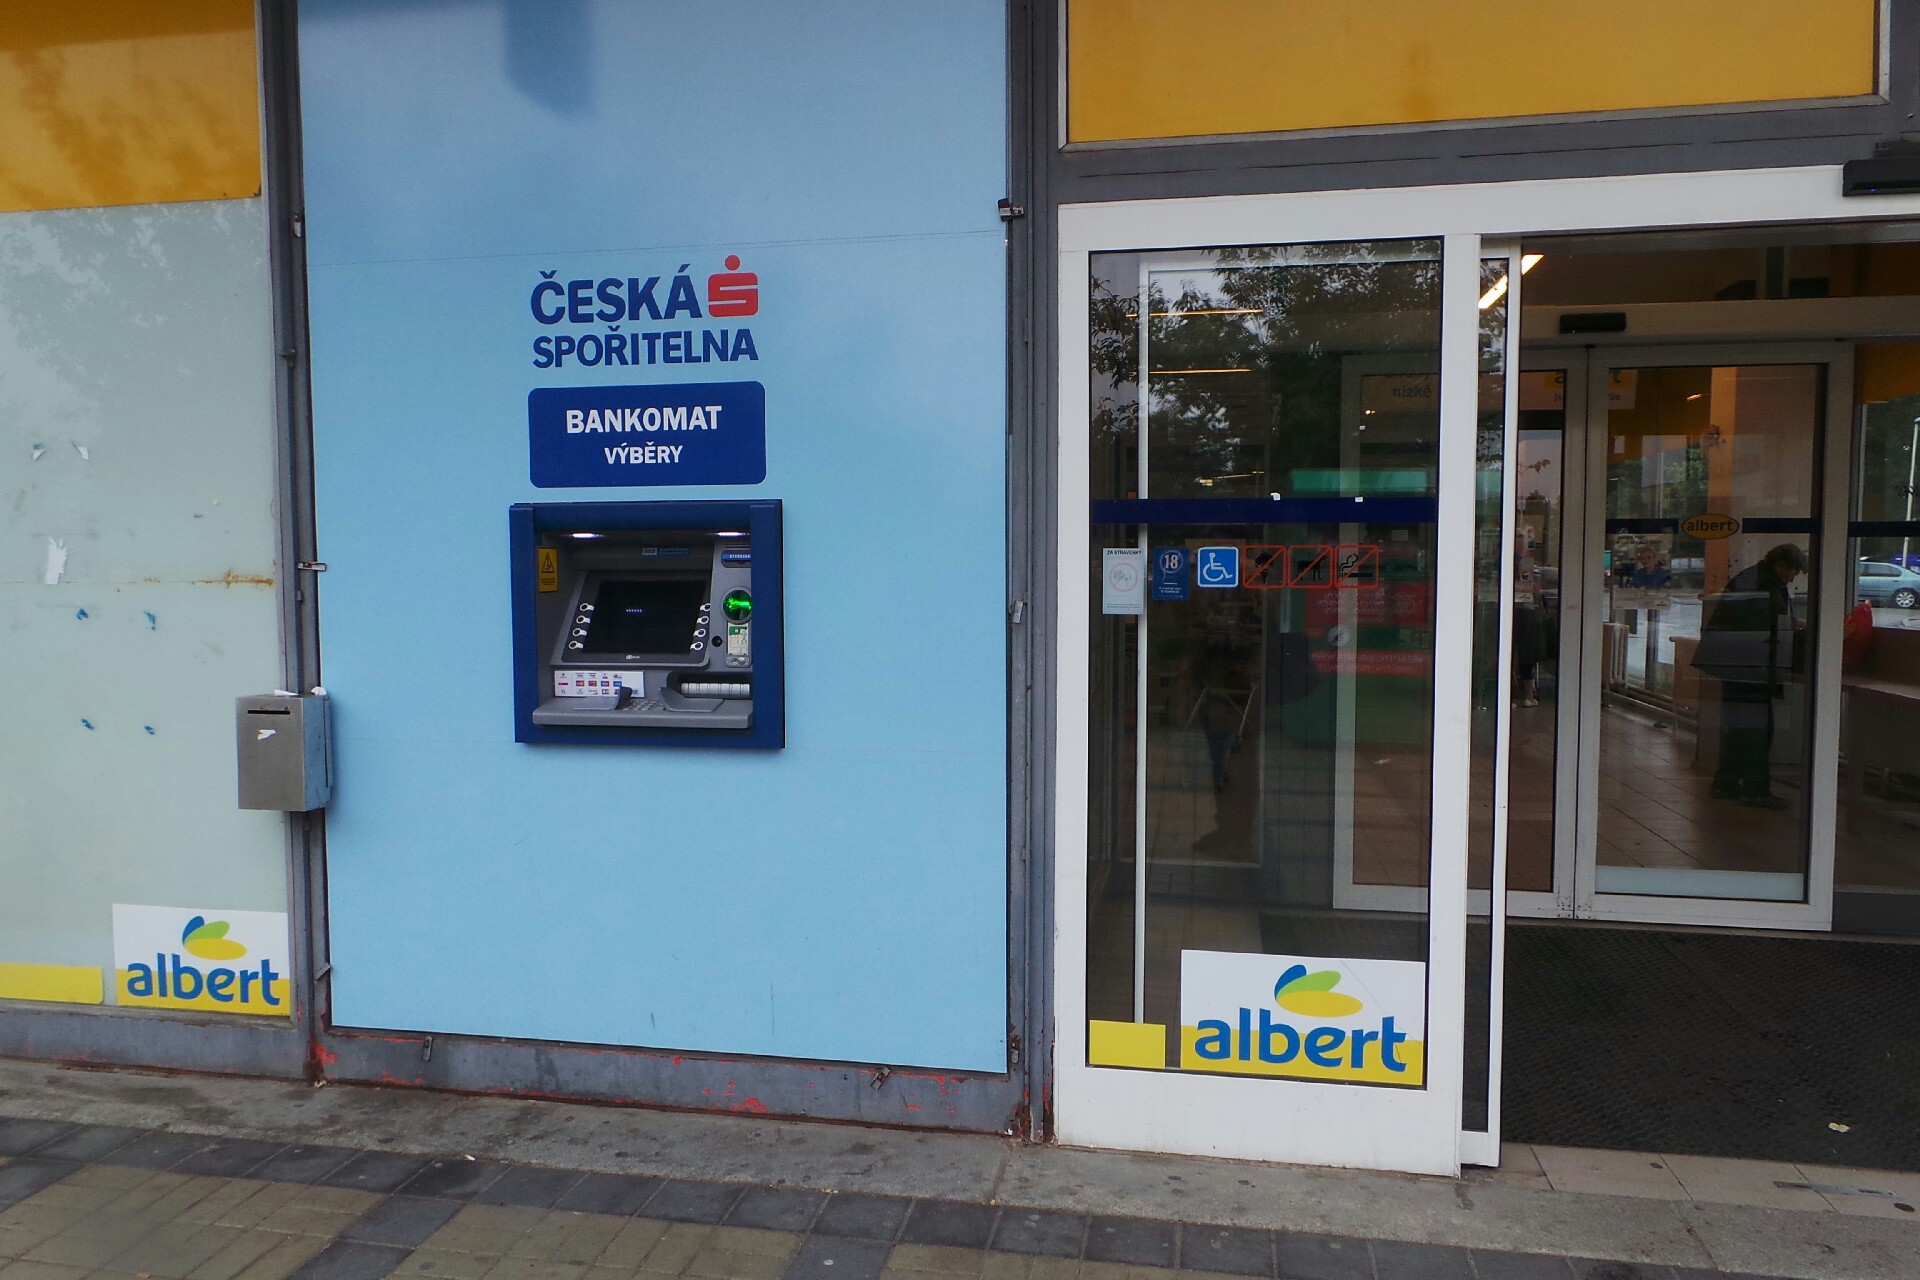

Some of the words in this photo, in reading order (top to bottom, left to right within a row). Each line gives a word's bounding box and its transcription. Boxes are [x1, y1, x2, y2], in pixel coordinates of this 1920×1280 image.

[530, 263, 703, 325] ČESKÁ
[532, 325, 759, 369] SPOŘITELNA
[566, 405, 723, 434] BANKOMAT
[604, 441, 683, 465] VÝBĚRY
[1686, 519, 1734, 531] albert
[1164, 554, 1179, 569] 18
[127, 952, 281, 1006] albert
[1194, 1007, 1408, 1073] albert
